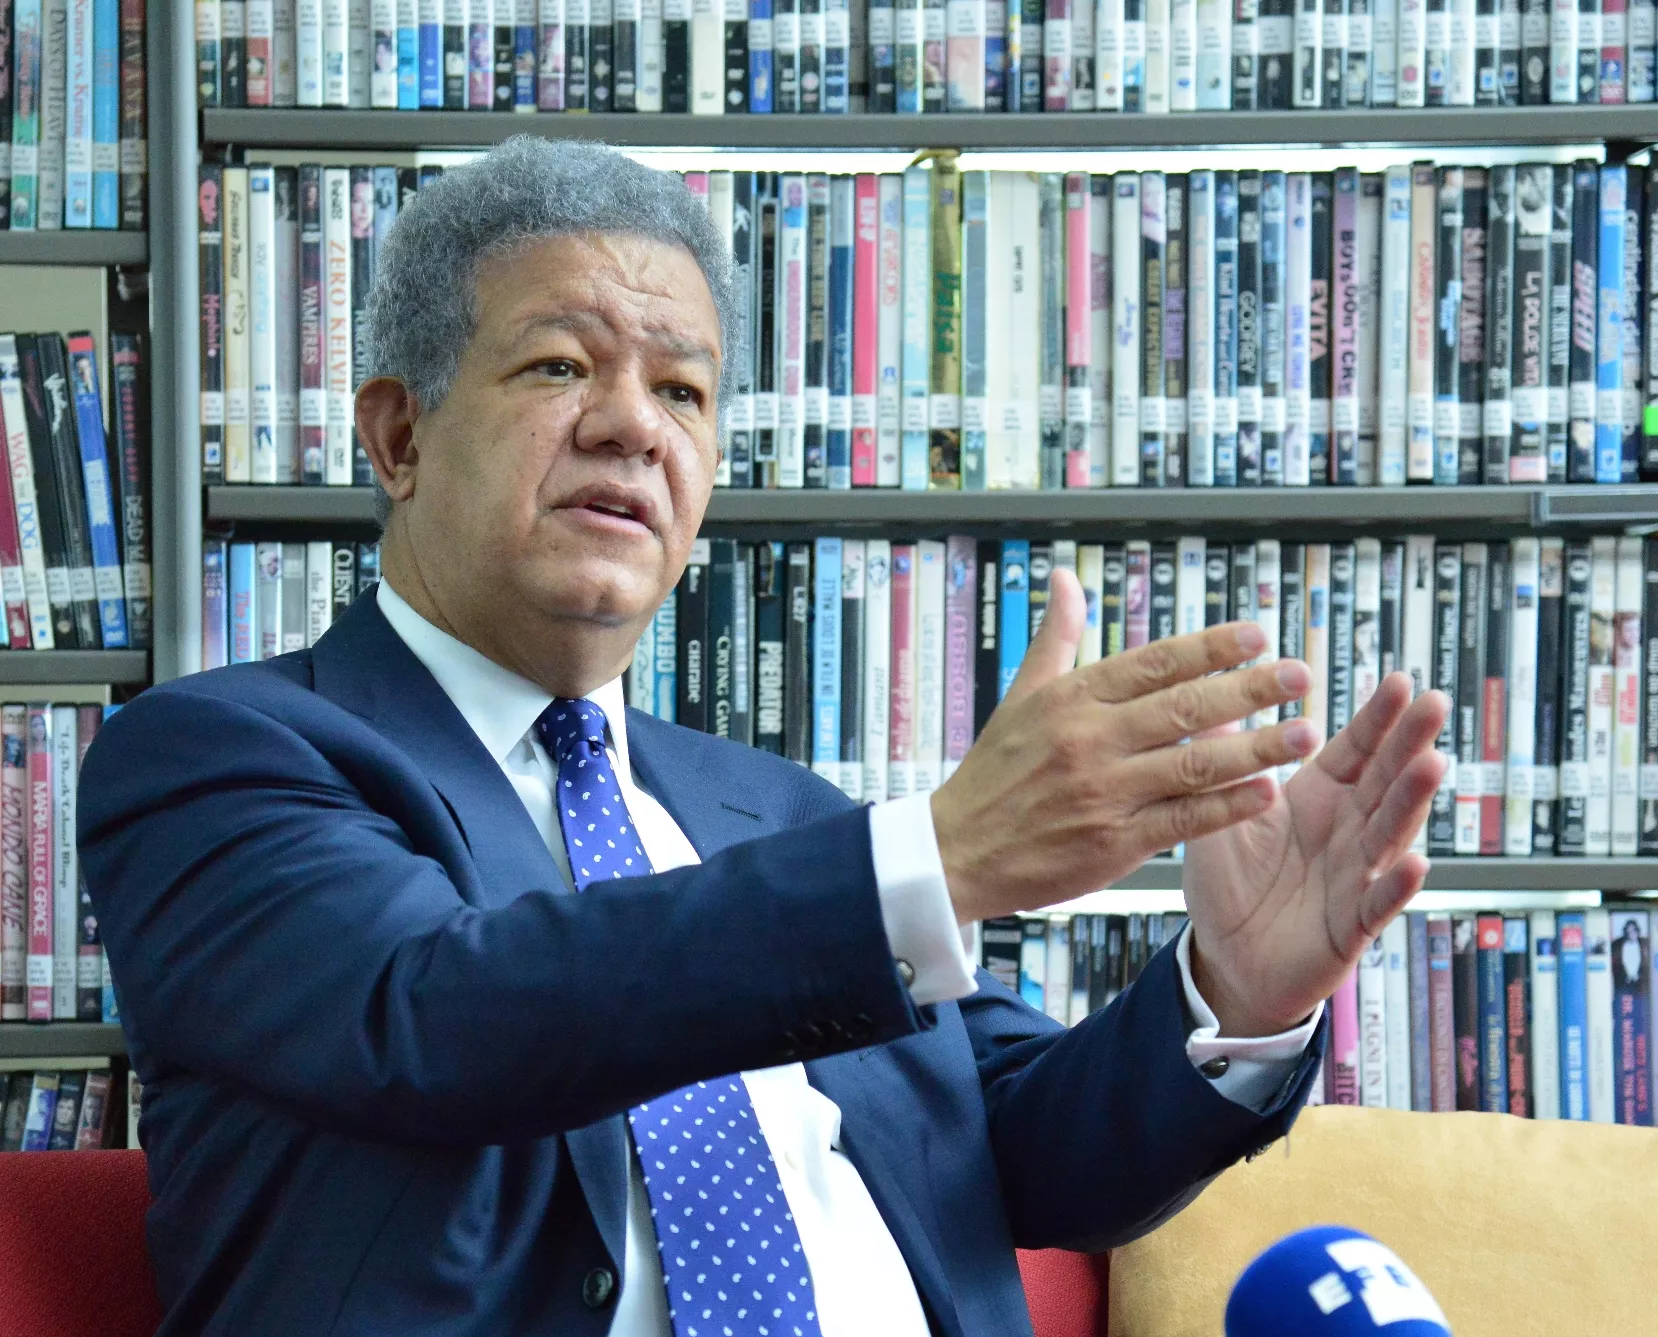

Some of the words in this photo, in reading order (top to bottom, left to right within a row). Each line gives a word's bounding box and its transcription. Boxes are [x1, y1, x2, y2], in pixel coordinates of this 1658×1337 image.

[124, 17, 143, 119] HAVANA
[329, 239, 346, 306] ZERO
[305, 284, 320, 365] VAMPIRES
[1239, 290, 1257, 373] GODFREY
[1311, 278, 1329, 362] EVITA
[1523, 296, 1539, 352] DOLCE
[1575, 261, 1596, 352] SPEED
[9, 432, 31, 480] WAG
[18, 502, 40, 549] DOG
[124, 495, 143, 540] DEAD
[334, 549, 354, 604] CLIENT
[715, 636, 732, 696] CRYING
[759, 641, 783, 734] PREDATOR
[2, 781, 25, 865] MONDO
[32, 780, 49, 832] MARIA
[33, 833, 47, 865] FULL
[33, 864, 47, 883] OF
[0, 870, 25, 934] CANE
[33, 884, 48, 936] GRACE
